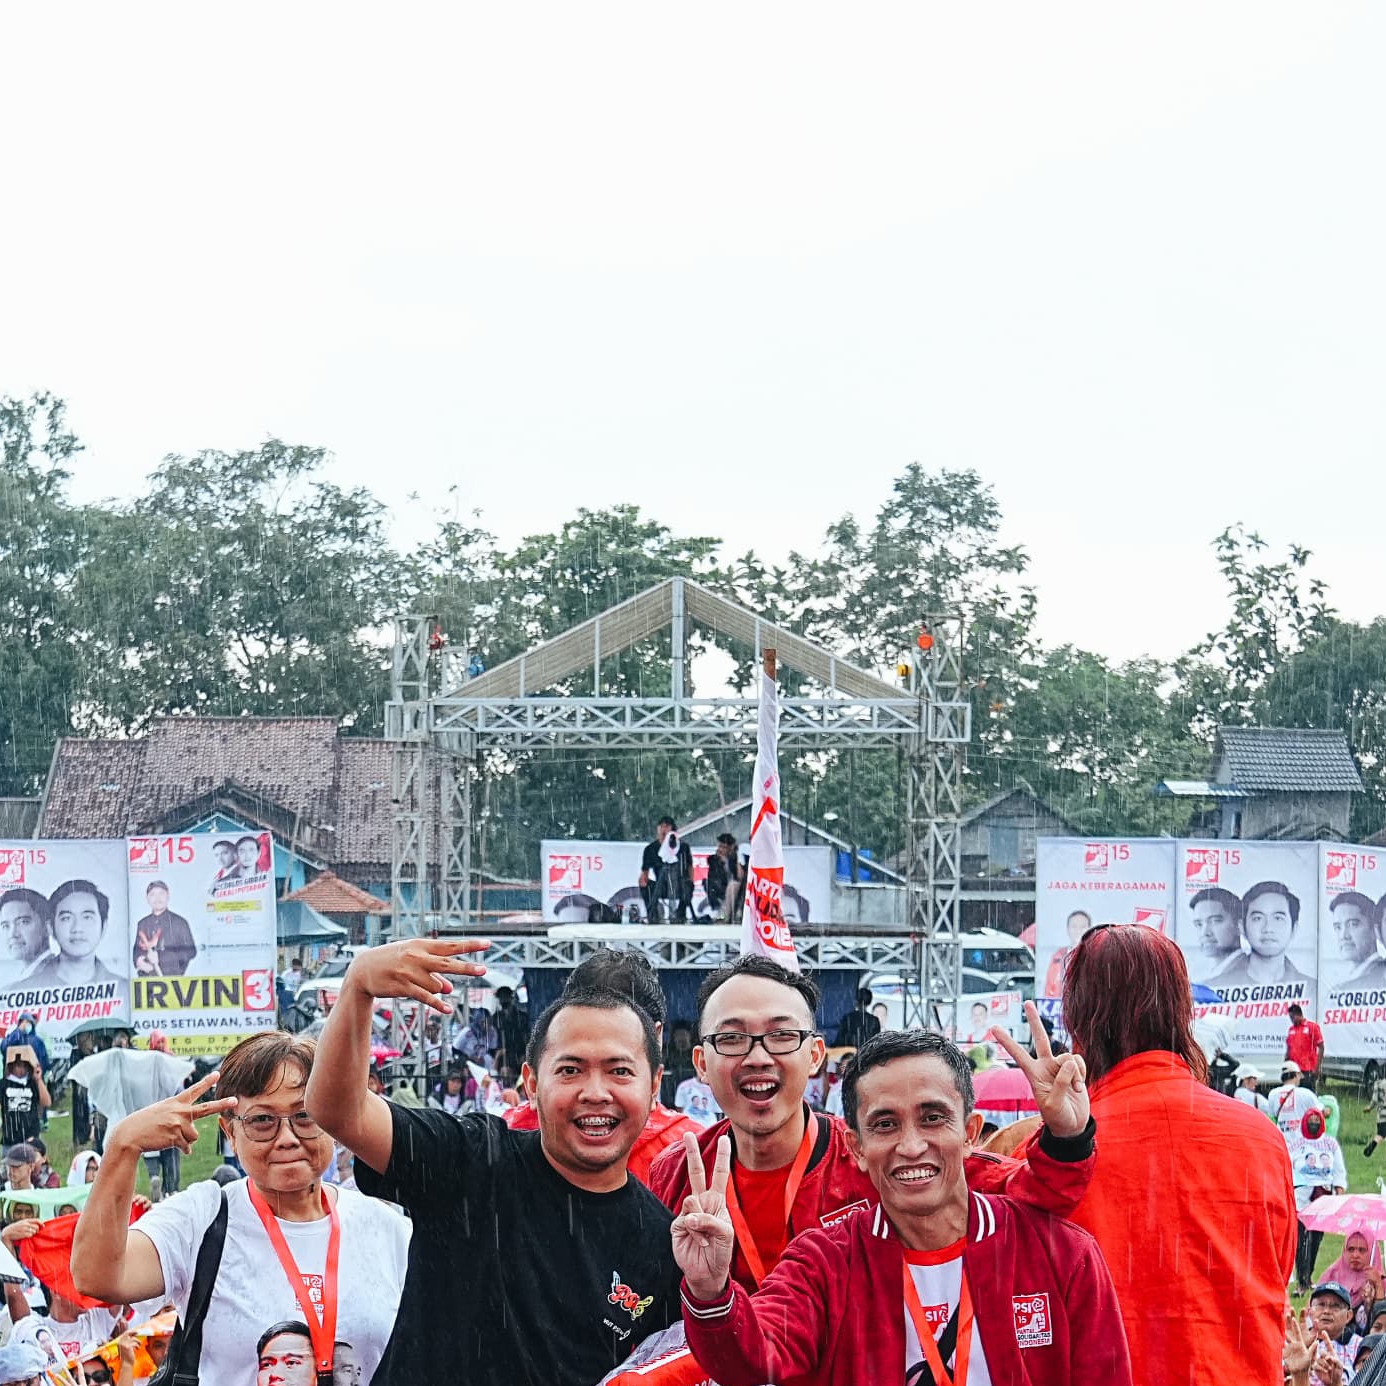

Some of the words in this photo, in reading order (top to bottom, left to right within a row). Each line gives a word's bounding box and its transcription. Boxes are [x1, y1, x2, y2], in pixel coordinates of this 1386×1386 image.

[29, 849, 46, 865] 15
[162, 836, 195, 864] 15
[1112, 844, 1129, 860] 15
[1224, 850, 1240, 864] 15
[586, 855, 603, 871] 15
[1361, 855, 1376, 871] 15
[1047, 880, 1077, 889] JAGA
[1080, 881, 1166, 891] KEBERAGAMAN
[61, 983, 115, 1004] GIBRAN
[134, 979, 240, 1009] IRVIN
[246, 972, 271, 1009] 3
[1251, 983, 1305, 1001] GIBRAN
[133, 1018, 167, 1030] AGUS
[171, 1017, 242, 1029] SETIAWAN,
[1324, 1008, 1369, 1025] SEKALI
[172, 1045, 211, 1054] STIMEWA
[1013, 1302, 1032, 1314] PSI
[925, 1310, 938, 1322] SI
[1017, 1315, 1027, 1324] 15
[1017, 1332, 1051, 1341] SOLIDARITAS
[1019, 1339, 1051, 1347] INDONESIA
